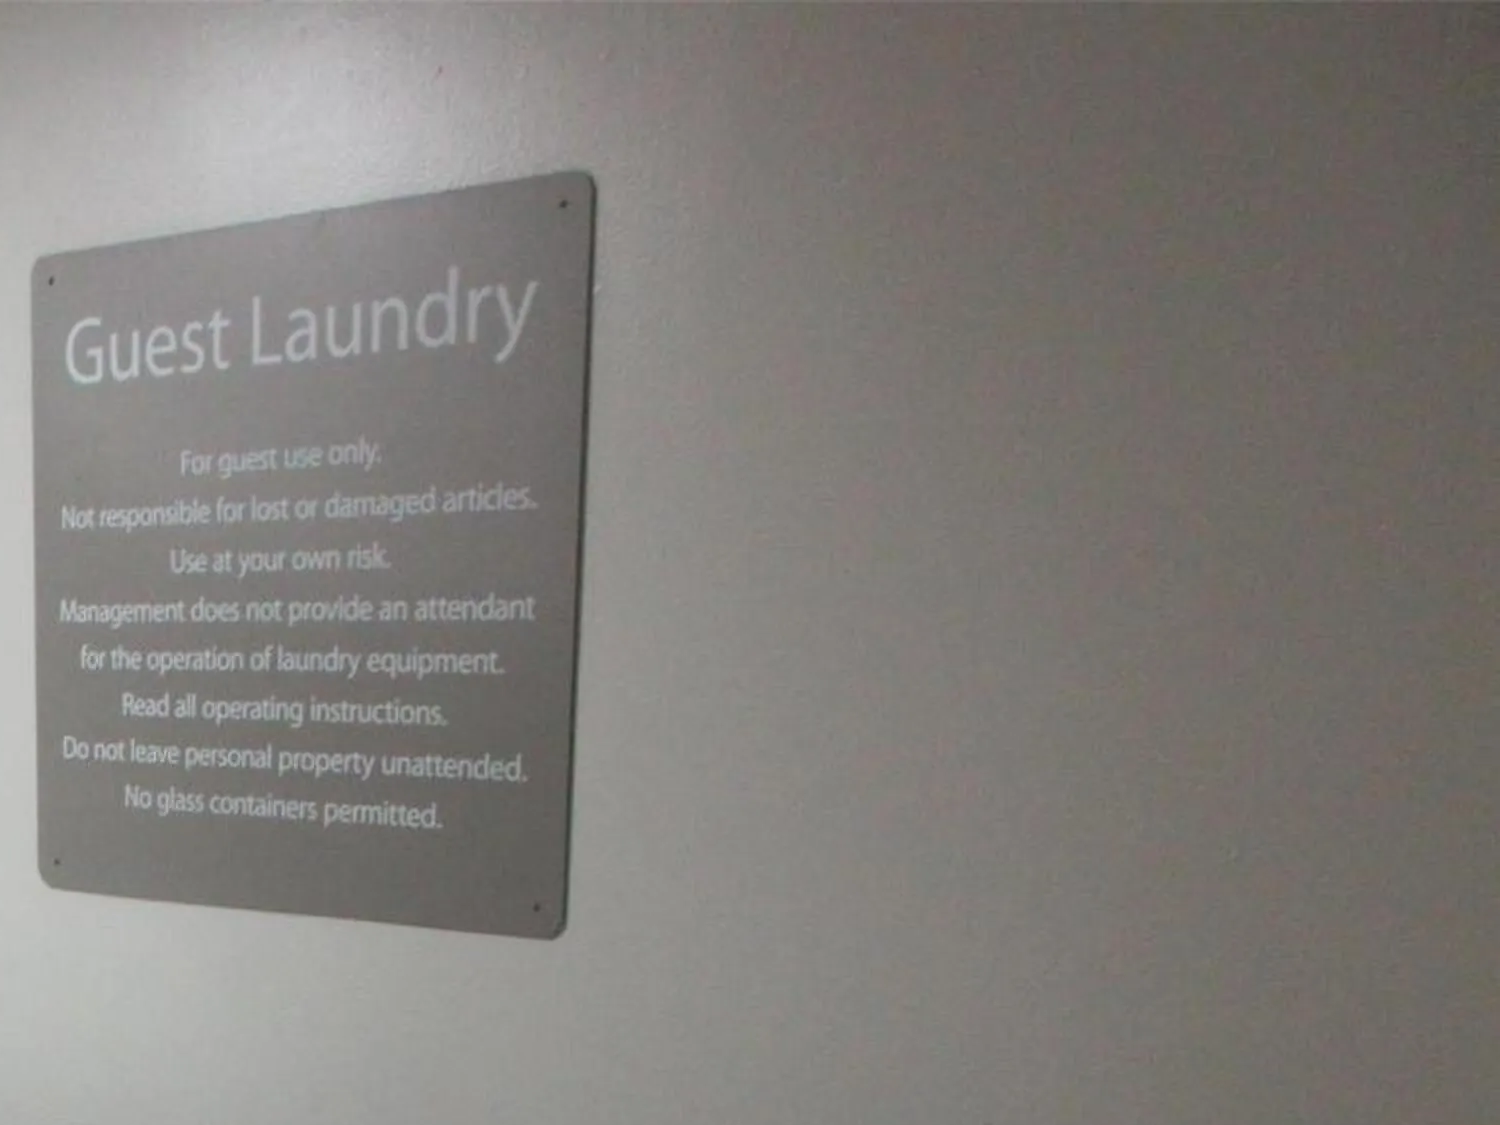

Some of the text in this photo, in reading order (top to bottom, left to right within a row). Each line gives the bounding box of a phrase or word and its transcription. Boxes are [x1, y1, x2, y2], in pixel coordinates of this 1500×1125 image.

[66, 264, 540, 385] Guest Laundry
[180, 435, 382, 480] For guest use only.
[61, 482, 539, 533] Not responsible for lost or damaged articles.
[169, 541, 392, 578] Use at your own risk.
[59, 592, 537, 629] Management does not provide an attendant
[80, 643, 506, 681] for the operation of laundry equipment.
[121, 691, 449, 728] Read all operating instructions.
[62, 736, 528, 783] Do not leave personal property unattended.
[124, 783, 444, 830] No glass containers permitted.
